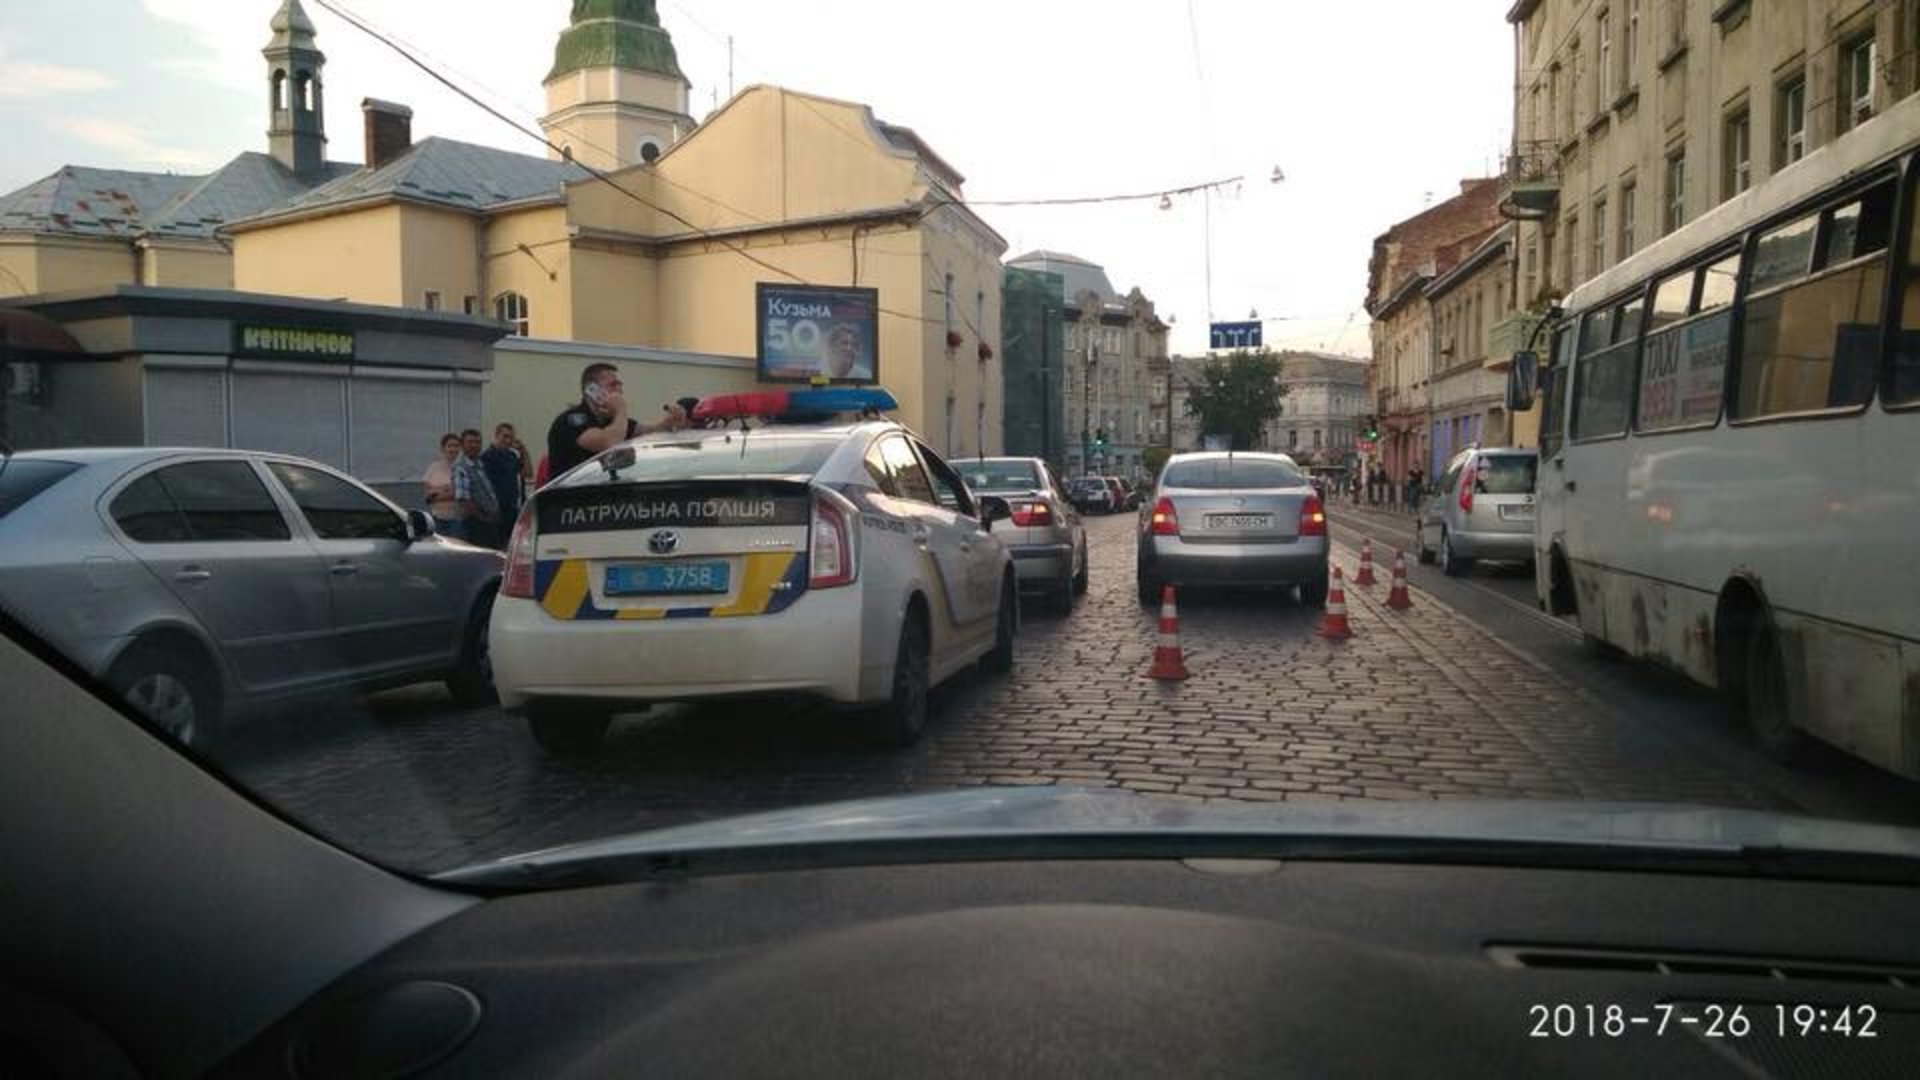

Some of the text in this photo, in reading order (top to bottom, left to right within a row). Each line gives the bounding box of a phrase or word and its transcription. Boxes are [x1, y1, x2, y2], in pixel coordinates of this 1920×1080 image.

[767, 318, 820, 351] 50
[561, 500, 776, 525] ПАТРУЛЬНА ПОЛІЦІЯ
[663, 567, 713, 588] 3758
